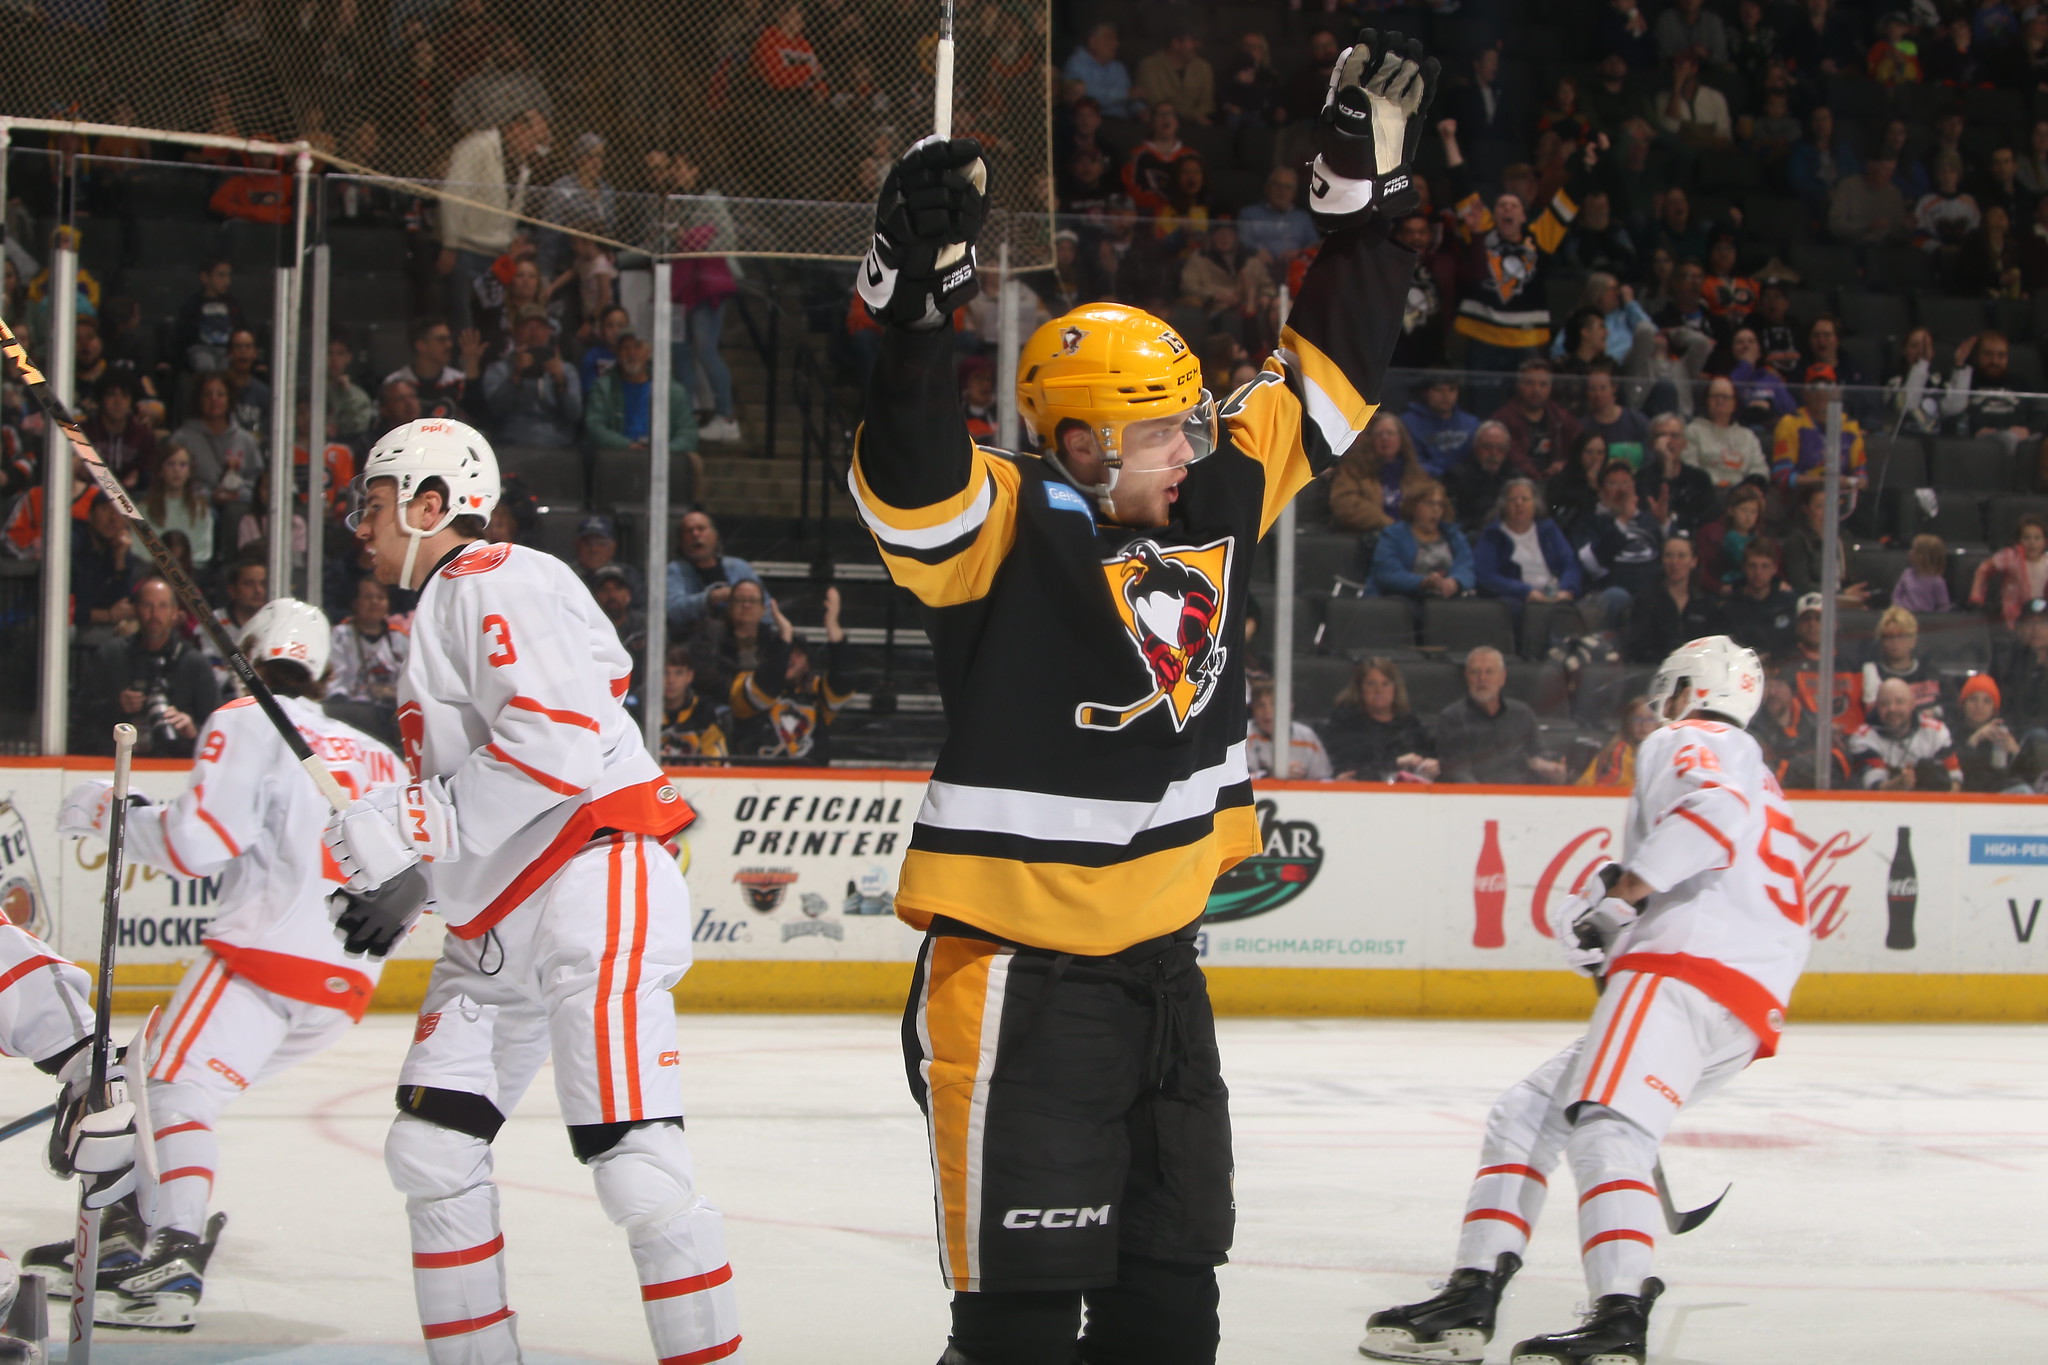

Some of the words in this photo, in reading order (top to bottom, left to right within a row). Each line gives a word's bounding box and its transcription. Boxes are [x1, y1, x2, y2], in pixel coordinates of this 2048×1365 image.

[942, 268, 972, 293] CCM
[482, 613, 518, 668] 3
[734, 796, 904, 823] OFFICIAL
[118, 917, 217, 946] HOCKE
[1216, 937, 1407, 956] @RICHMARFLORIST
[207, 1057, 251, 1092] CCM
[1002, 1204, 1112, 1230] CCM
